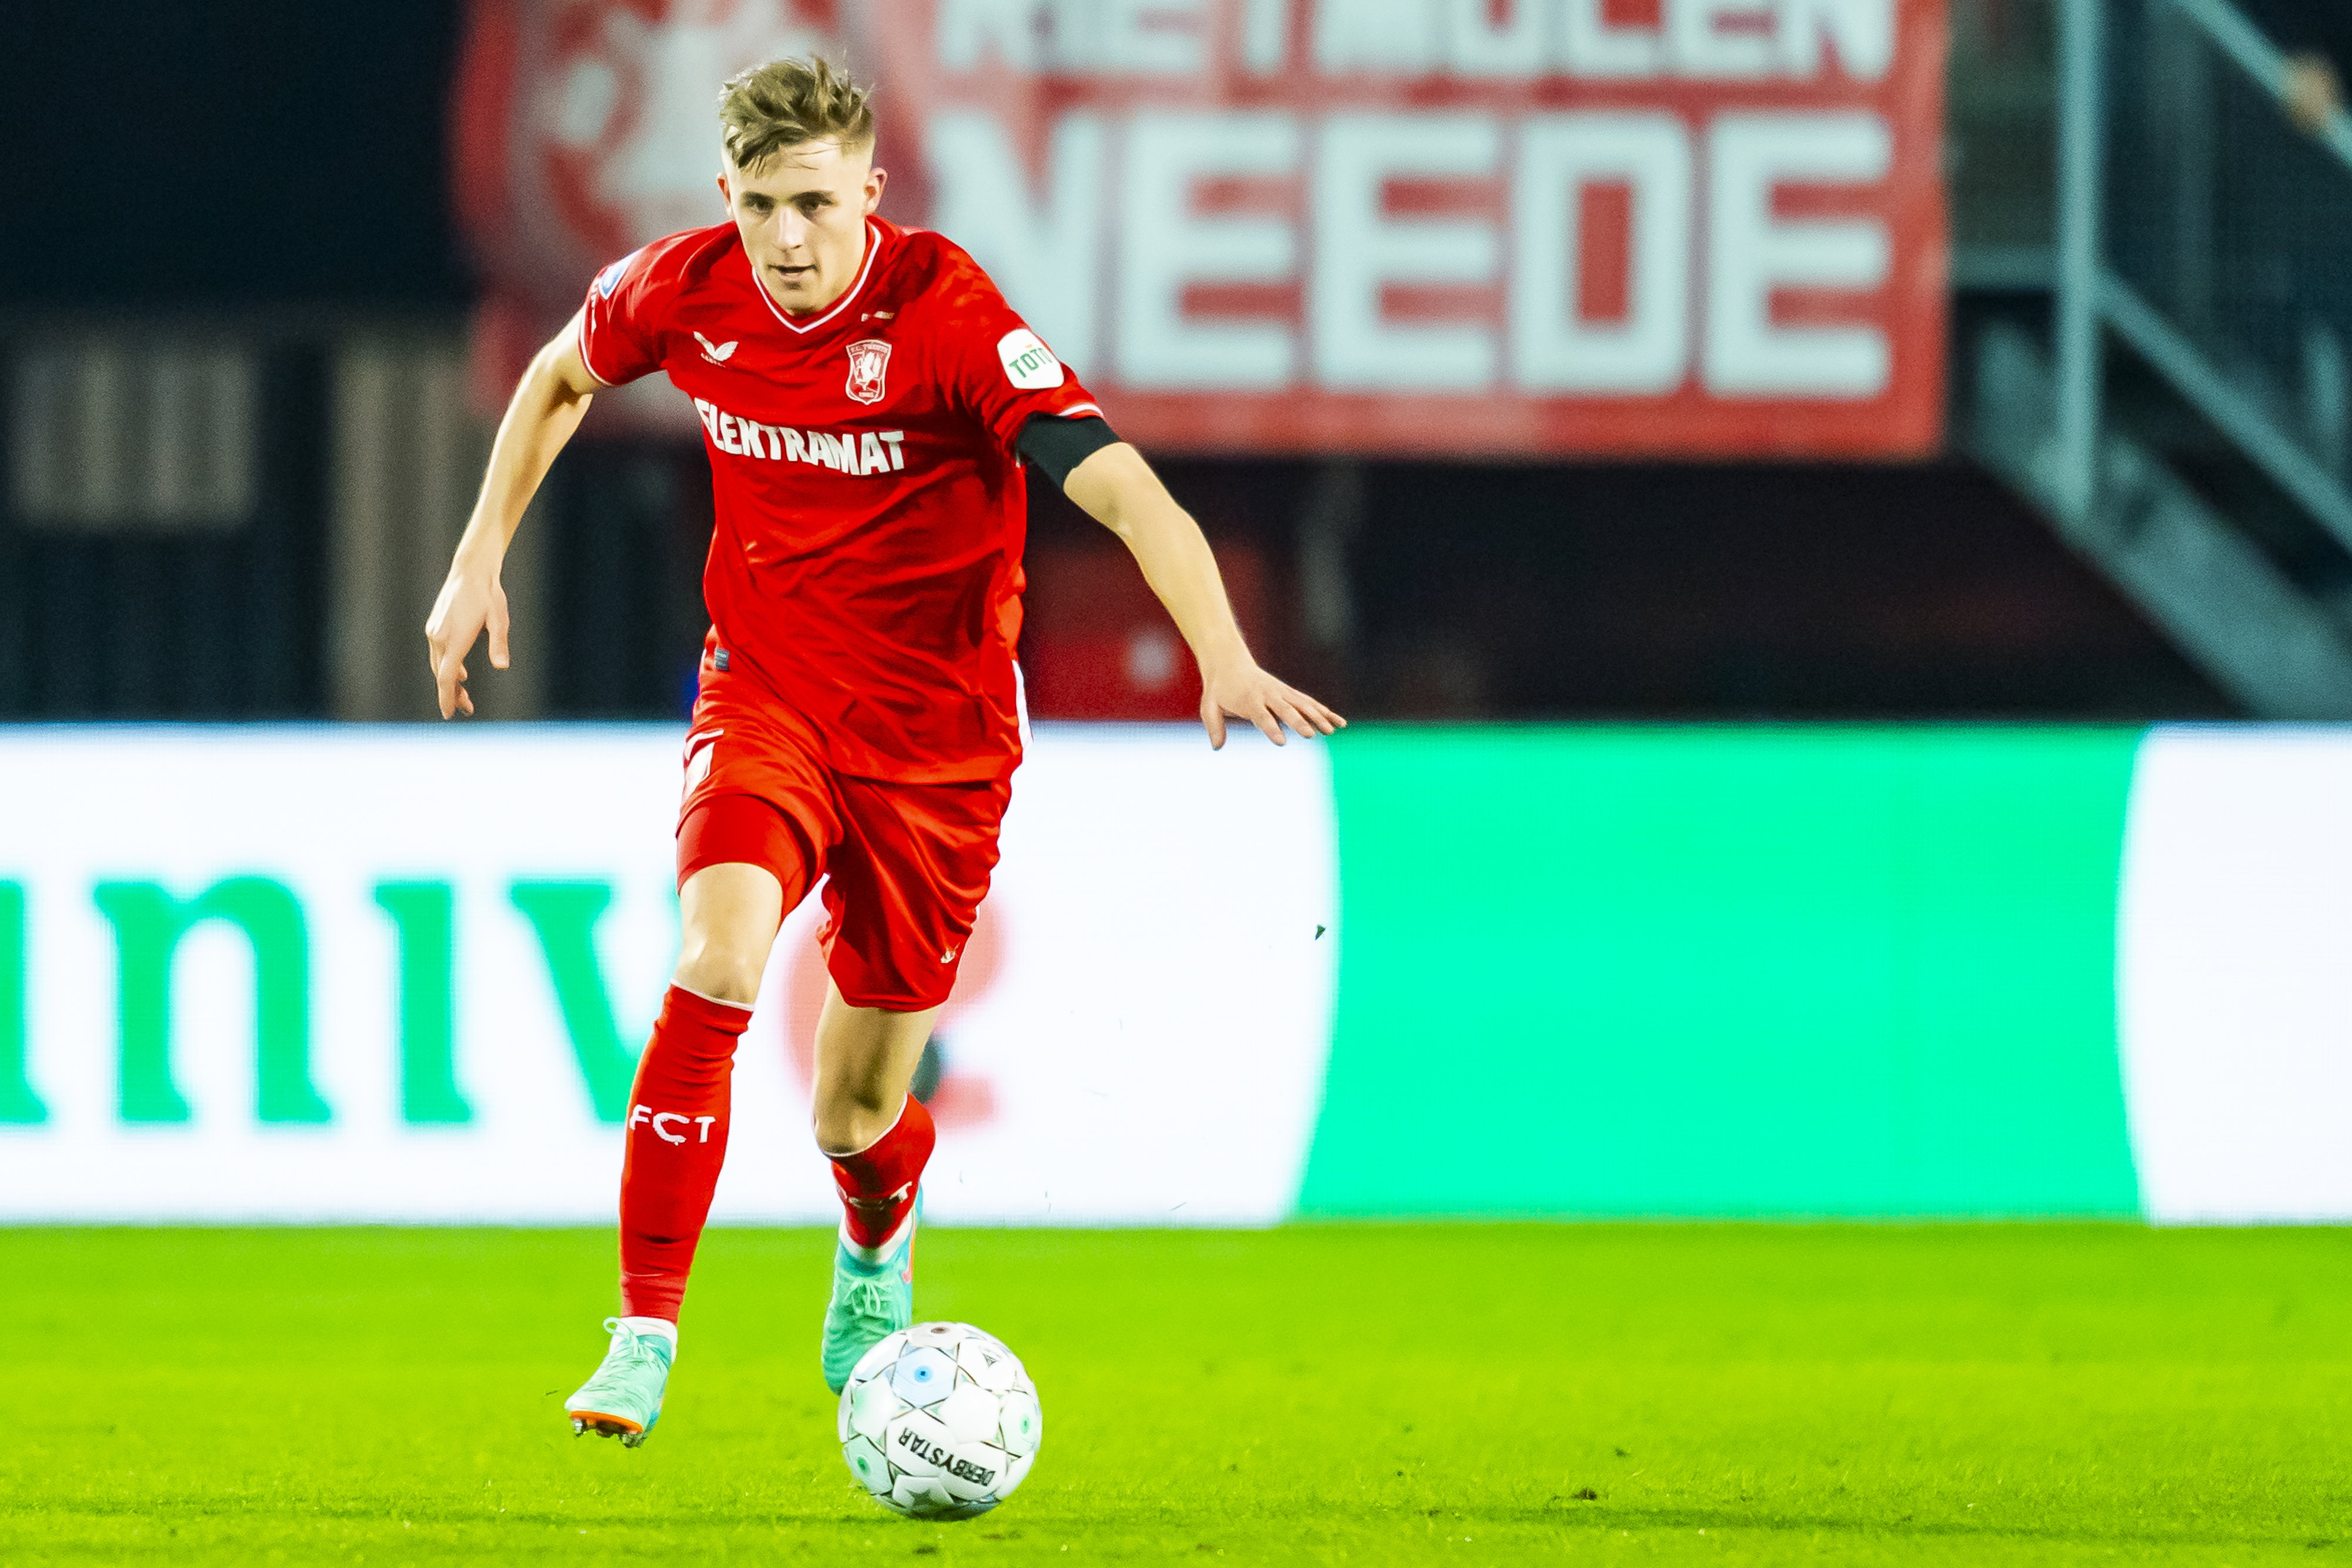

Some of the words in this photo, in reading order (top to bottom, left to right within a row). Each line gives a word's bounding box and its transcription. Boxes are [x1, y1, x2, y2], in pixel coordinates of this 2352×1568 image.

[929, 109, 1895, 399] NEEDE
[694, 397, 904, 476] ELEKTRAMAT
[629, 1104, 716, 1146] FCT
[898, 1427, 995, 1486] DERBYSTAR
